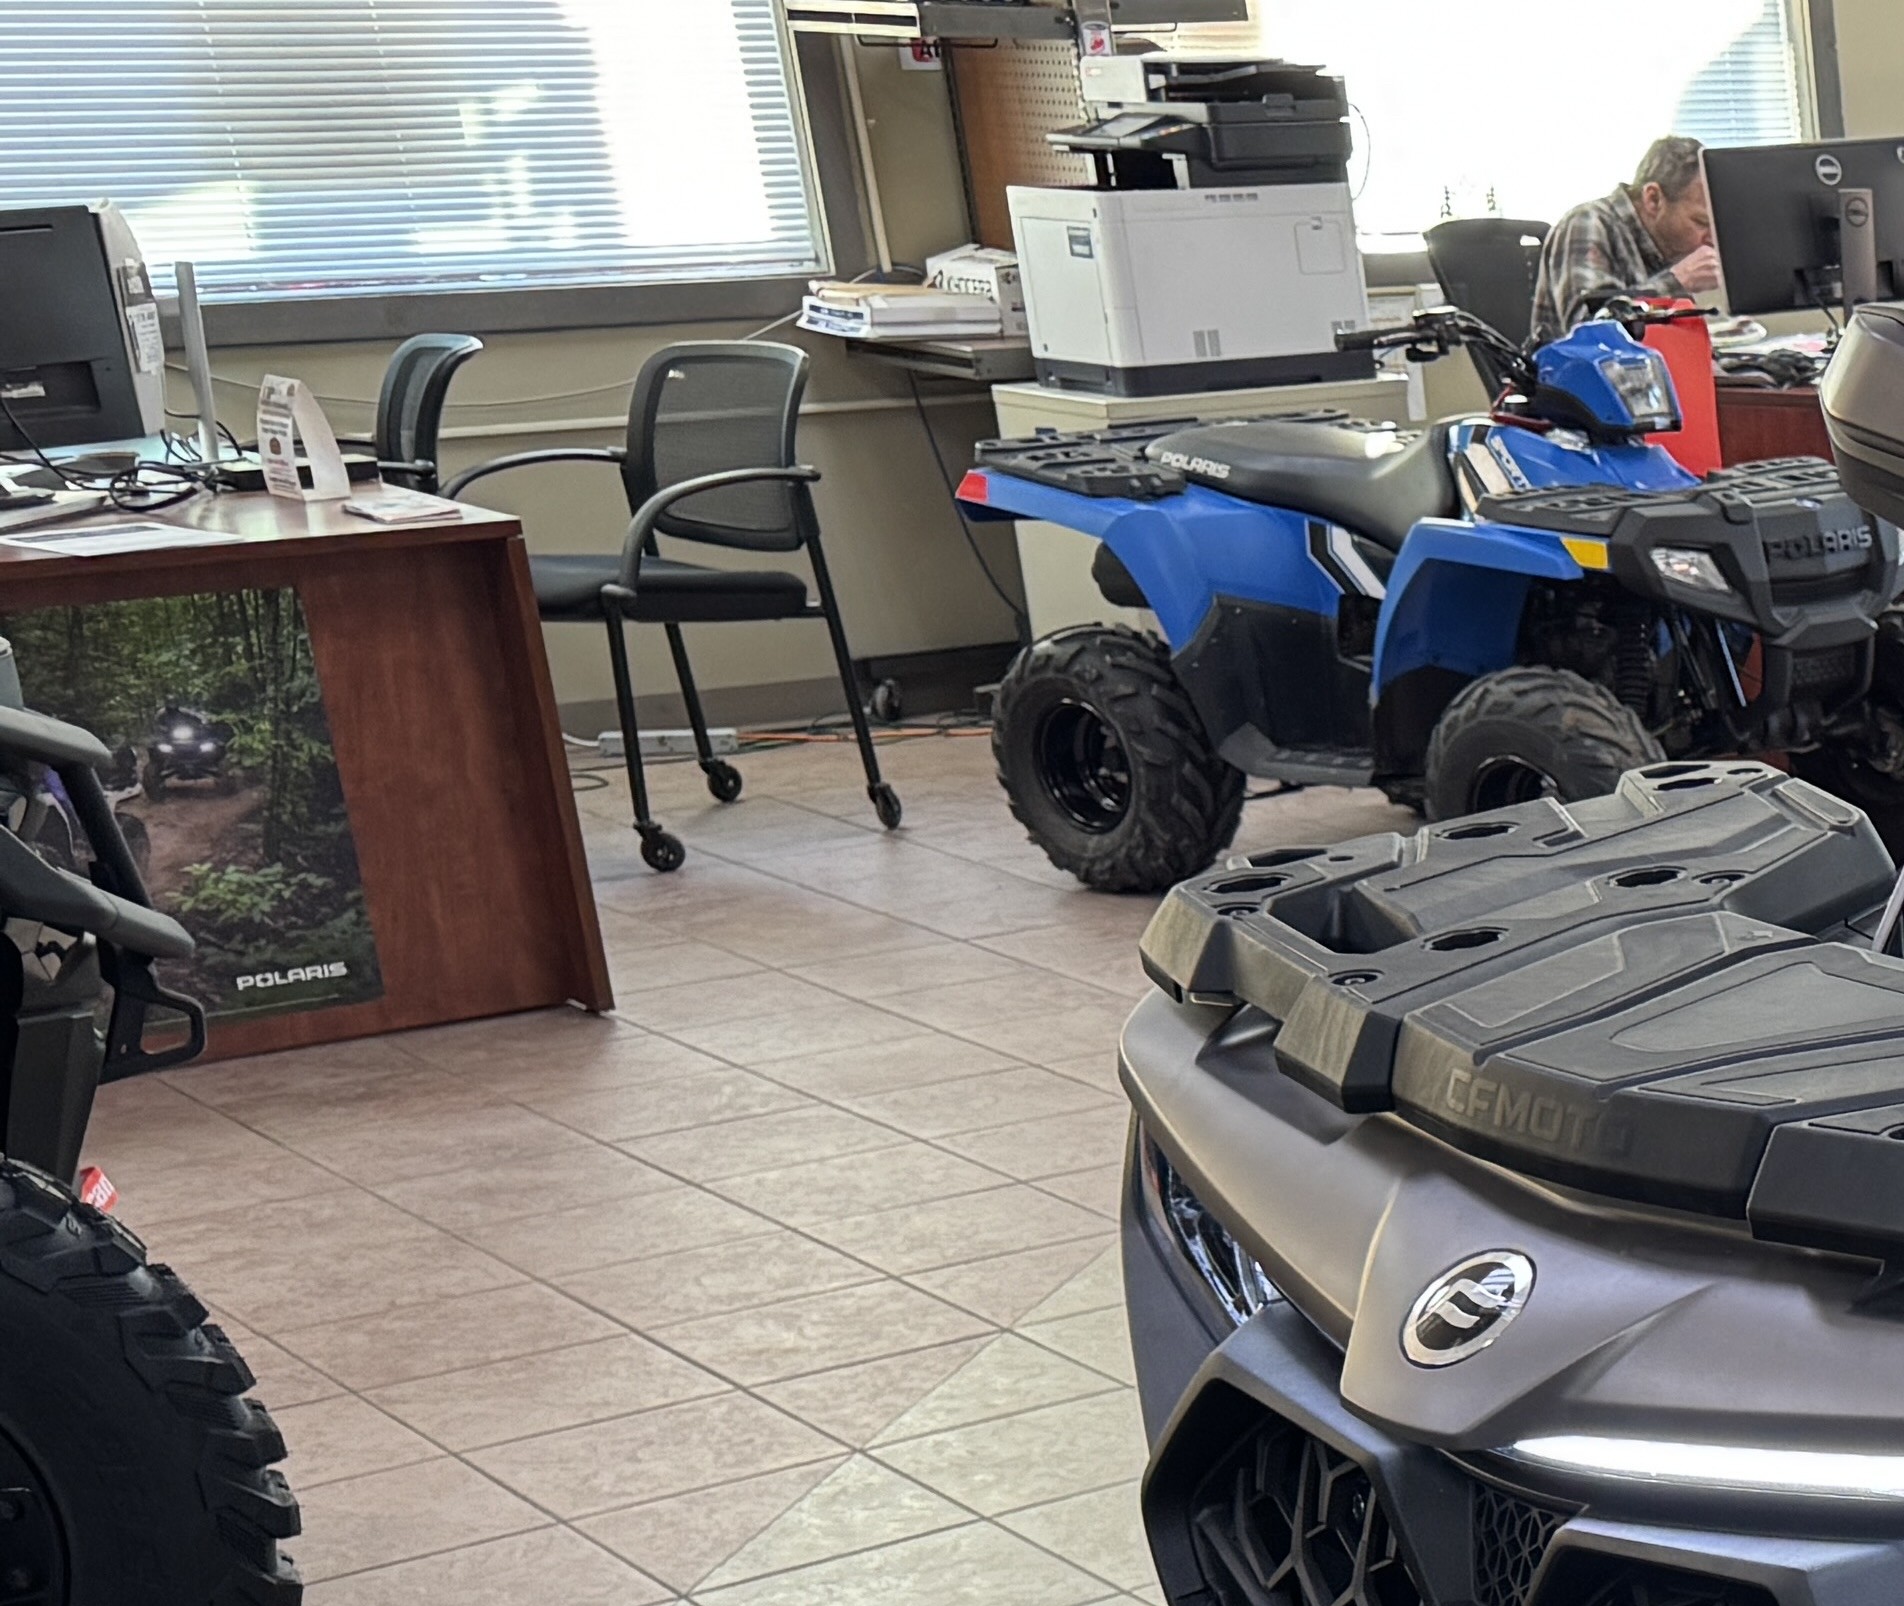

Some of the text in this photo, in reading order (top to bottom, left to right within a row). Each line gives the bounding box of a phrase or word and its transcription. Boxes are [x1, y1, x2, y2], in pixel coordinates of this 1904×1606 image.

[1161, 451, 1231, 479] POLARIS
[1762, 525, 1873, 561] POLARIS
[236, 961, 348, 991] POLARIS
